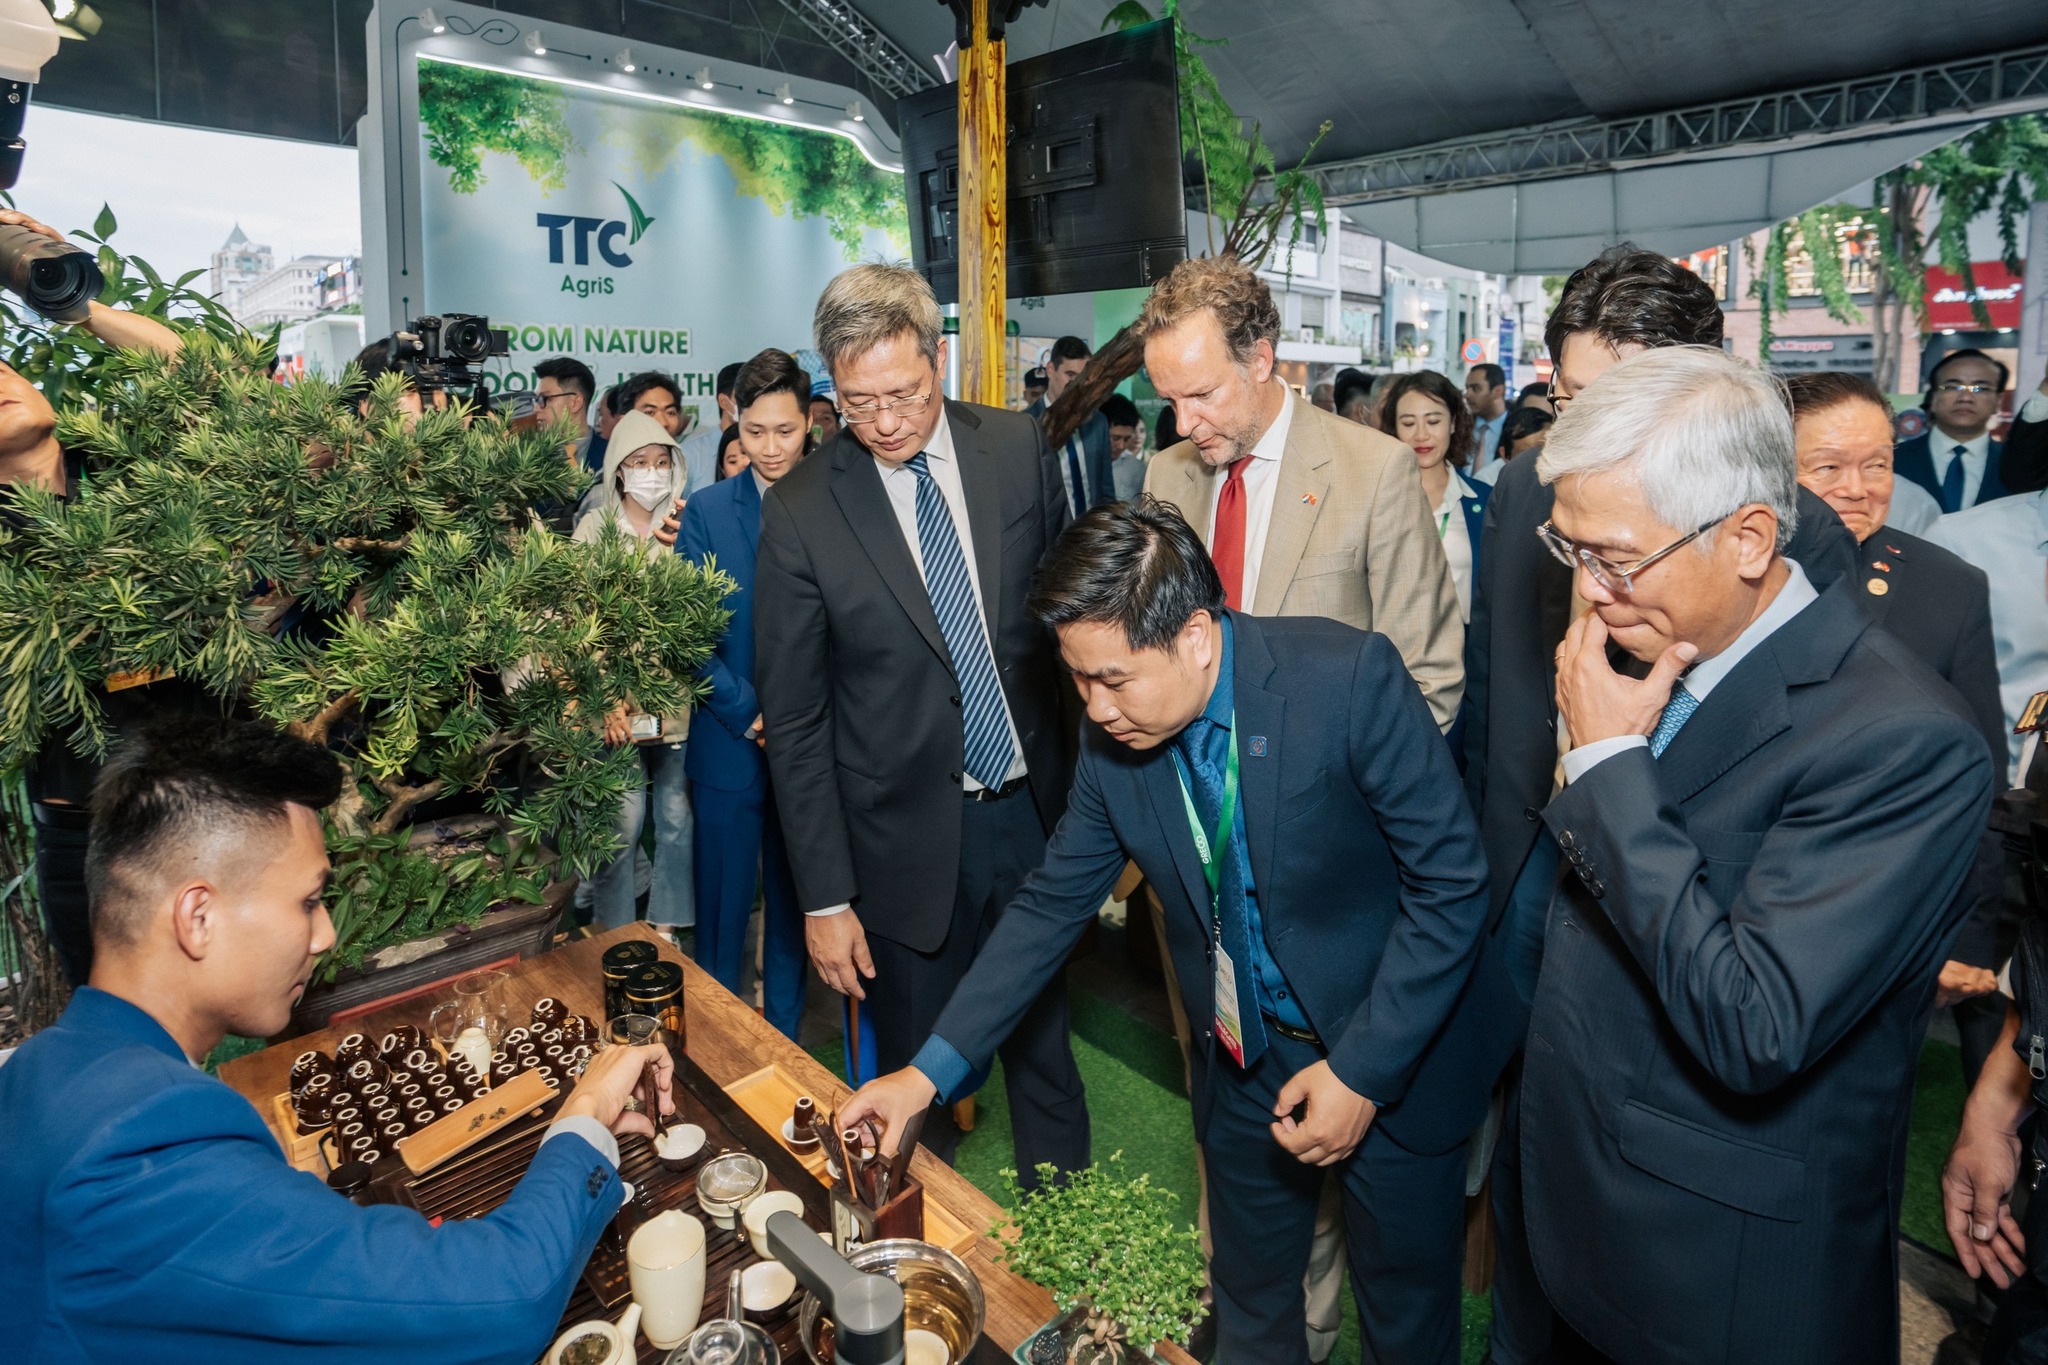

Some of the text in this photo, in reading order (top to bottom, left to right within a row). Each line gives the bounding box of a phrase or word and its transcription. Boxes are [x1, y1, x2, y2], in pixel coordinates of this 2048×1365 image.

[537, 212, 633, 268] TTC
[560, 274, 614, 298] AgriS
[487, 325, 688, 355] ROM NATURE
